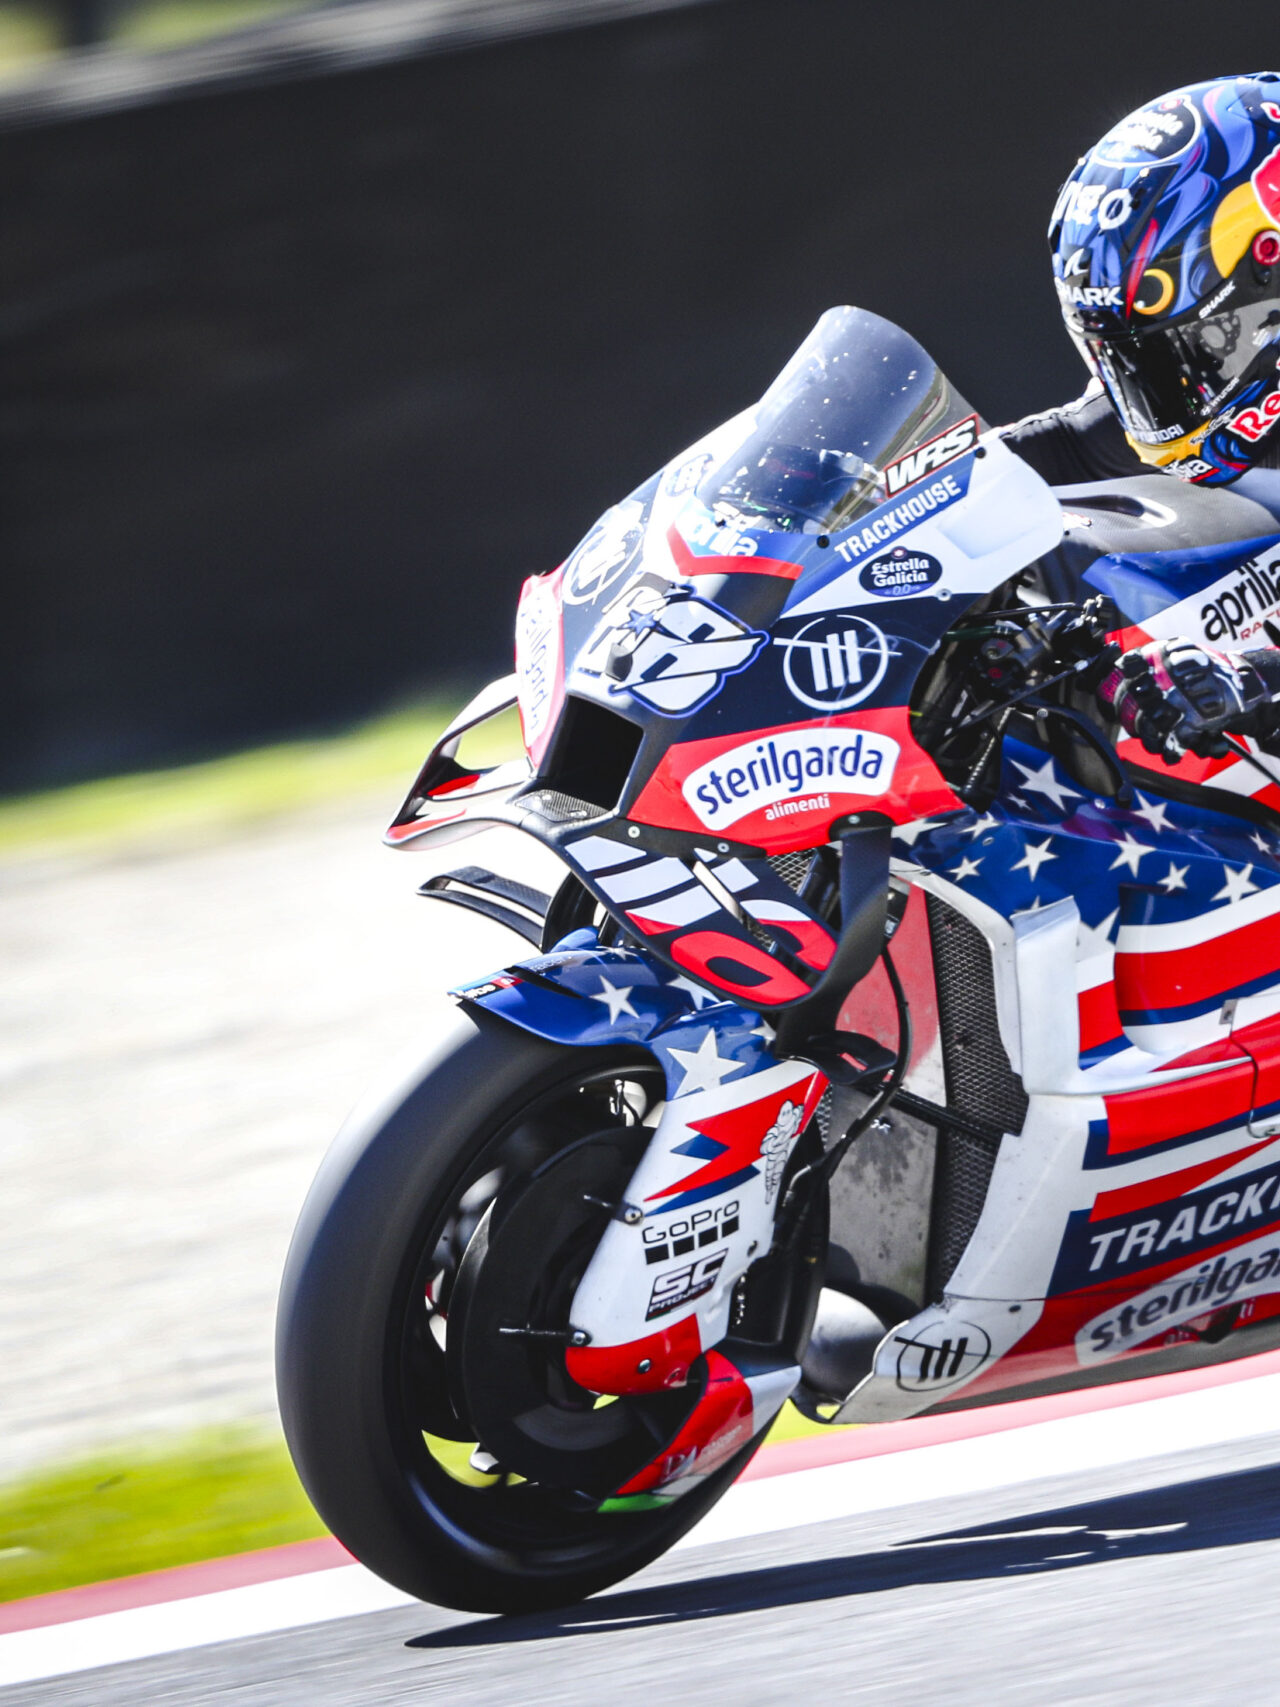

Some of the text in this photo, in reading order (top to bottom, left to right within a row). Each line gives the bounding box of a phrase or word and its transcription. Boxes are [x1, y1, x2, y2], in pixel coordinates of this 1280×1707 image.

[1199, 280, 1236, 319] SHARK
[887, 419, 976, 494] WRS
[833, 474, 962, 564] TRACKHOUSE
[871, 557, 930, 575] Estrella
[873, 570, 928, 587] Galicia
[697, 734, 885, 815] sterilgarda
[765, 793, 830, 821] alimenti
[642, 1200, 739, 1244] GoPro
[652, 1248, 728, 1304] SC
